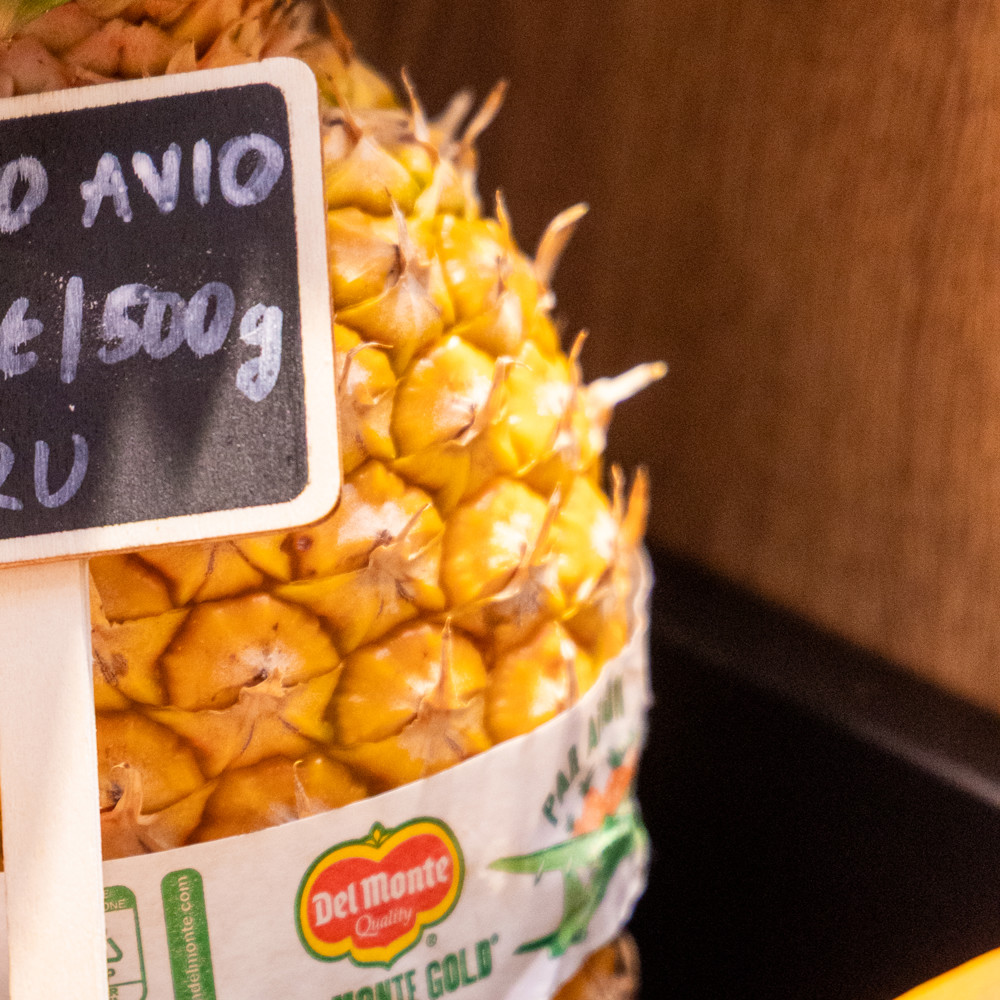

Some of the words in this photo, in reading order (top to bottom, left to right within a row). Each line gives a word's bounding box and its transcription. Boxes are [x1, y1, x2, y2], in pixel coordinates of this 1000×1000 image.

[81, 133, 285, 228] AVIO
[312, 881, 359, 927] Del
[359, 854, 449, 910] Monte
[354, 906, 414, 938] Quality
